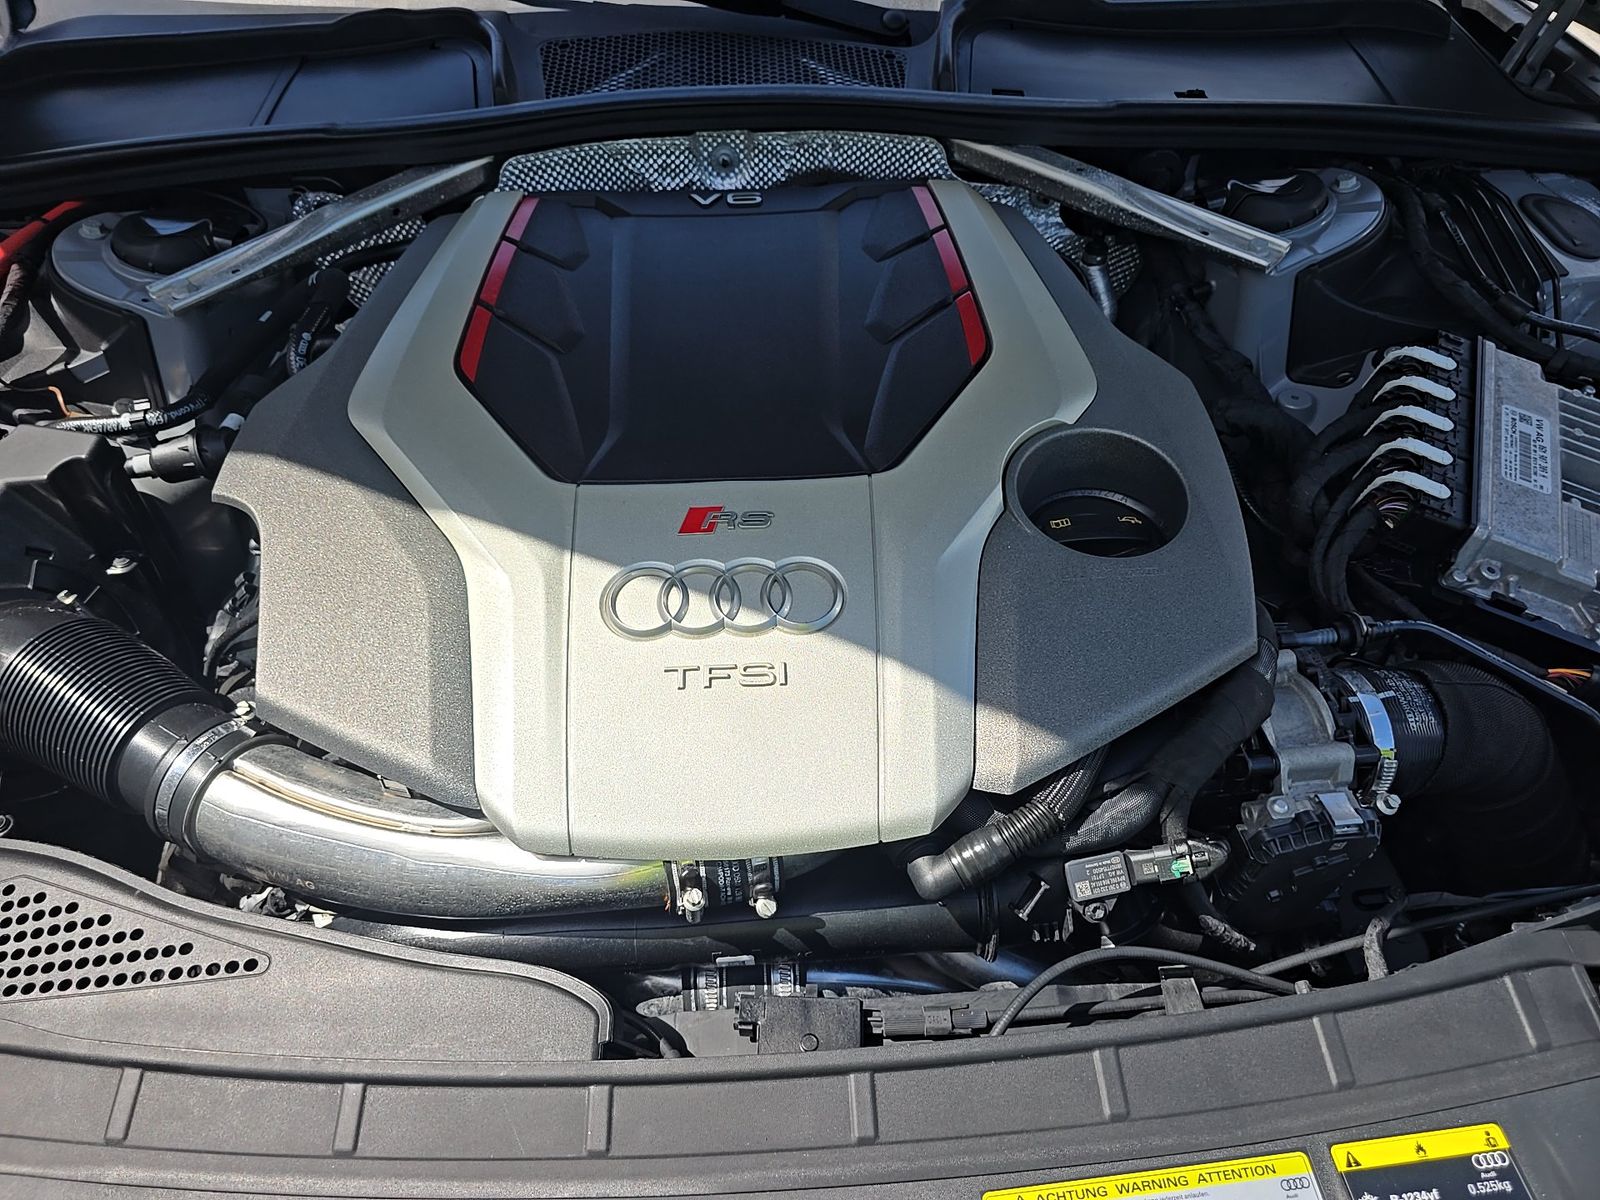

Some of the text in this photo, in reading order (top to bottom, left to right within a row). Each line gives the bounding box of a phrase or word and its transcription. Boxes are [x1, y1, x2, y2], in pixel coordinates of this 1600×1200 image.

[688, 191, 763, 208] V6
[700, 510, 775, 531] RS
[663, 661, 788, 690] TFSI
[1037, 1163, 1277, 1200] ACHTUNG WARNING ATTENTION
[1467, 1180, 1513, 1195] 0.525kg
